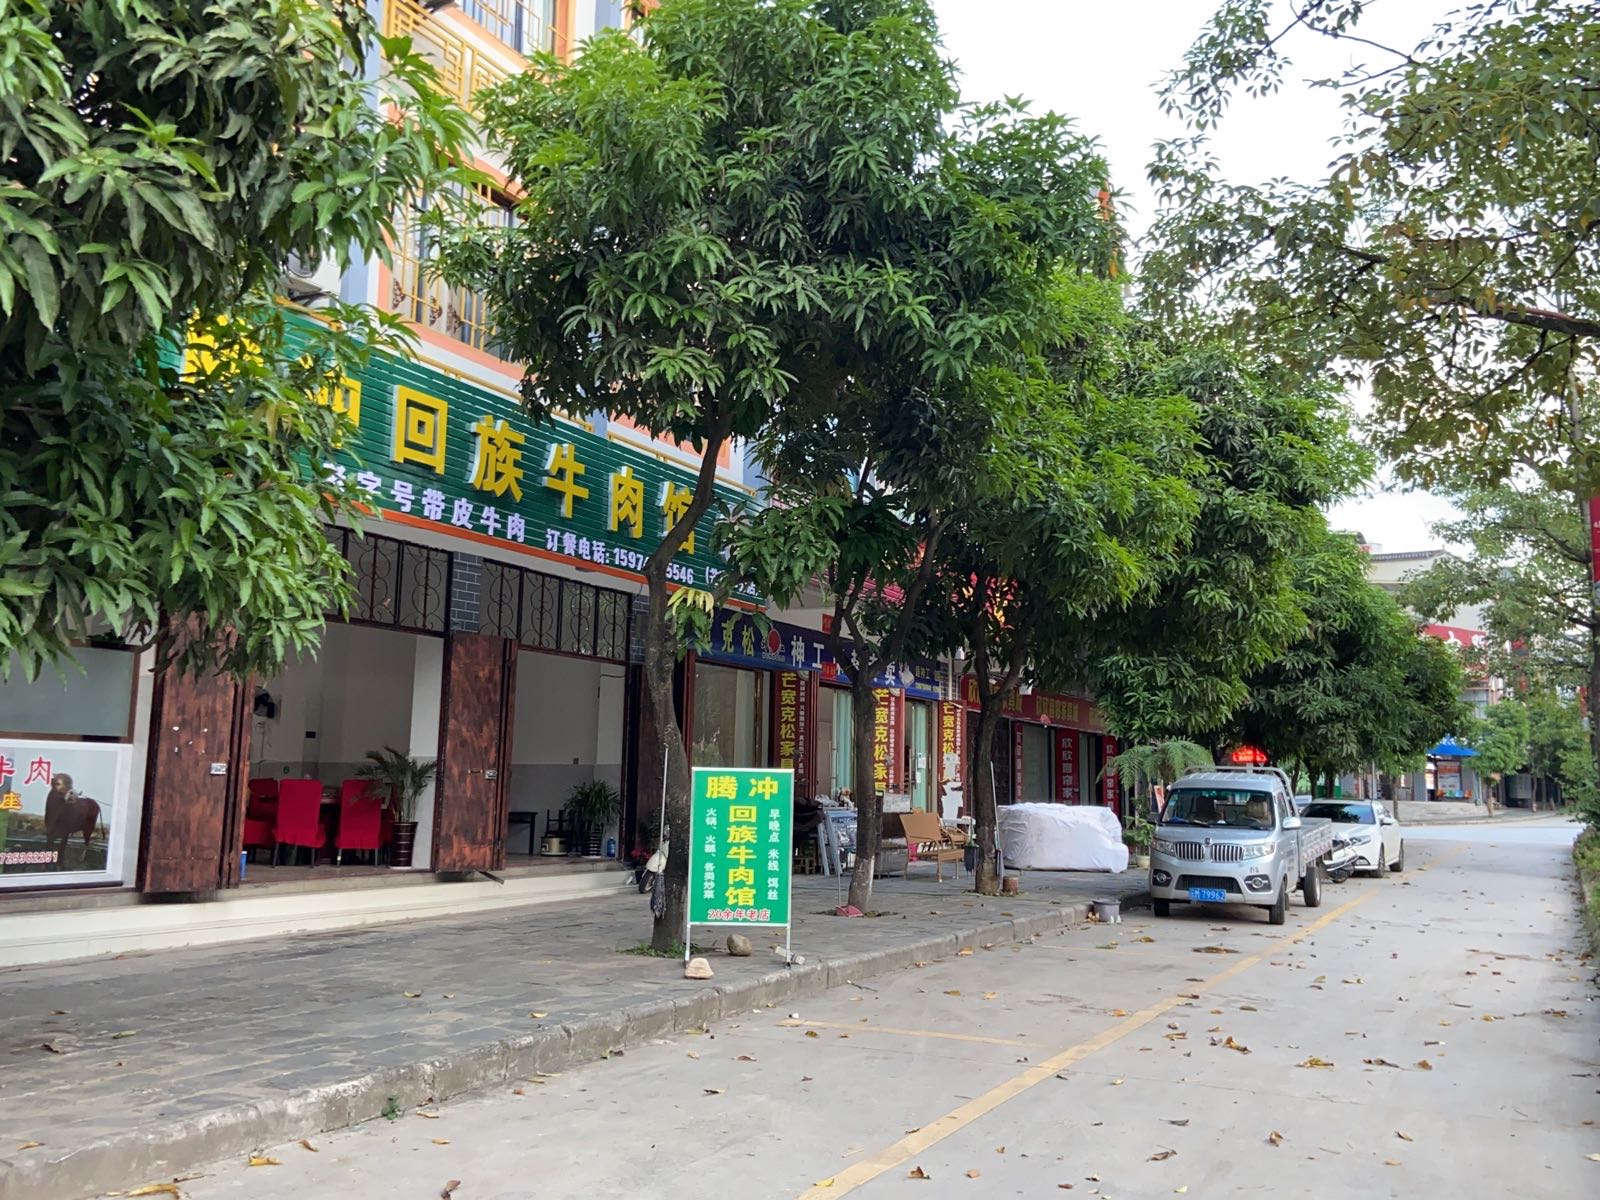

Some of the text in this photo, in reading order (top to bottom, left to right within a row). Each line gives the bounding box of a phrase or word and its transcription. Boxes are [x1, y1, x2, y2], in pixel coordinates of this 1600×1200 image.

[705, 775, 779, 800] 腾冲
[726, 805, 757, 906] 回族牛肉馆
[767, 848, 779, 872] 米线
[767, 877, 779, 900] 饵丝
[707, 908, 771, 921] 20余年老店
